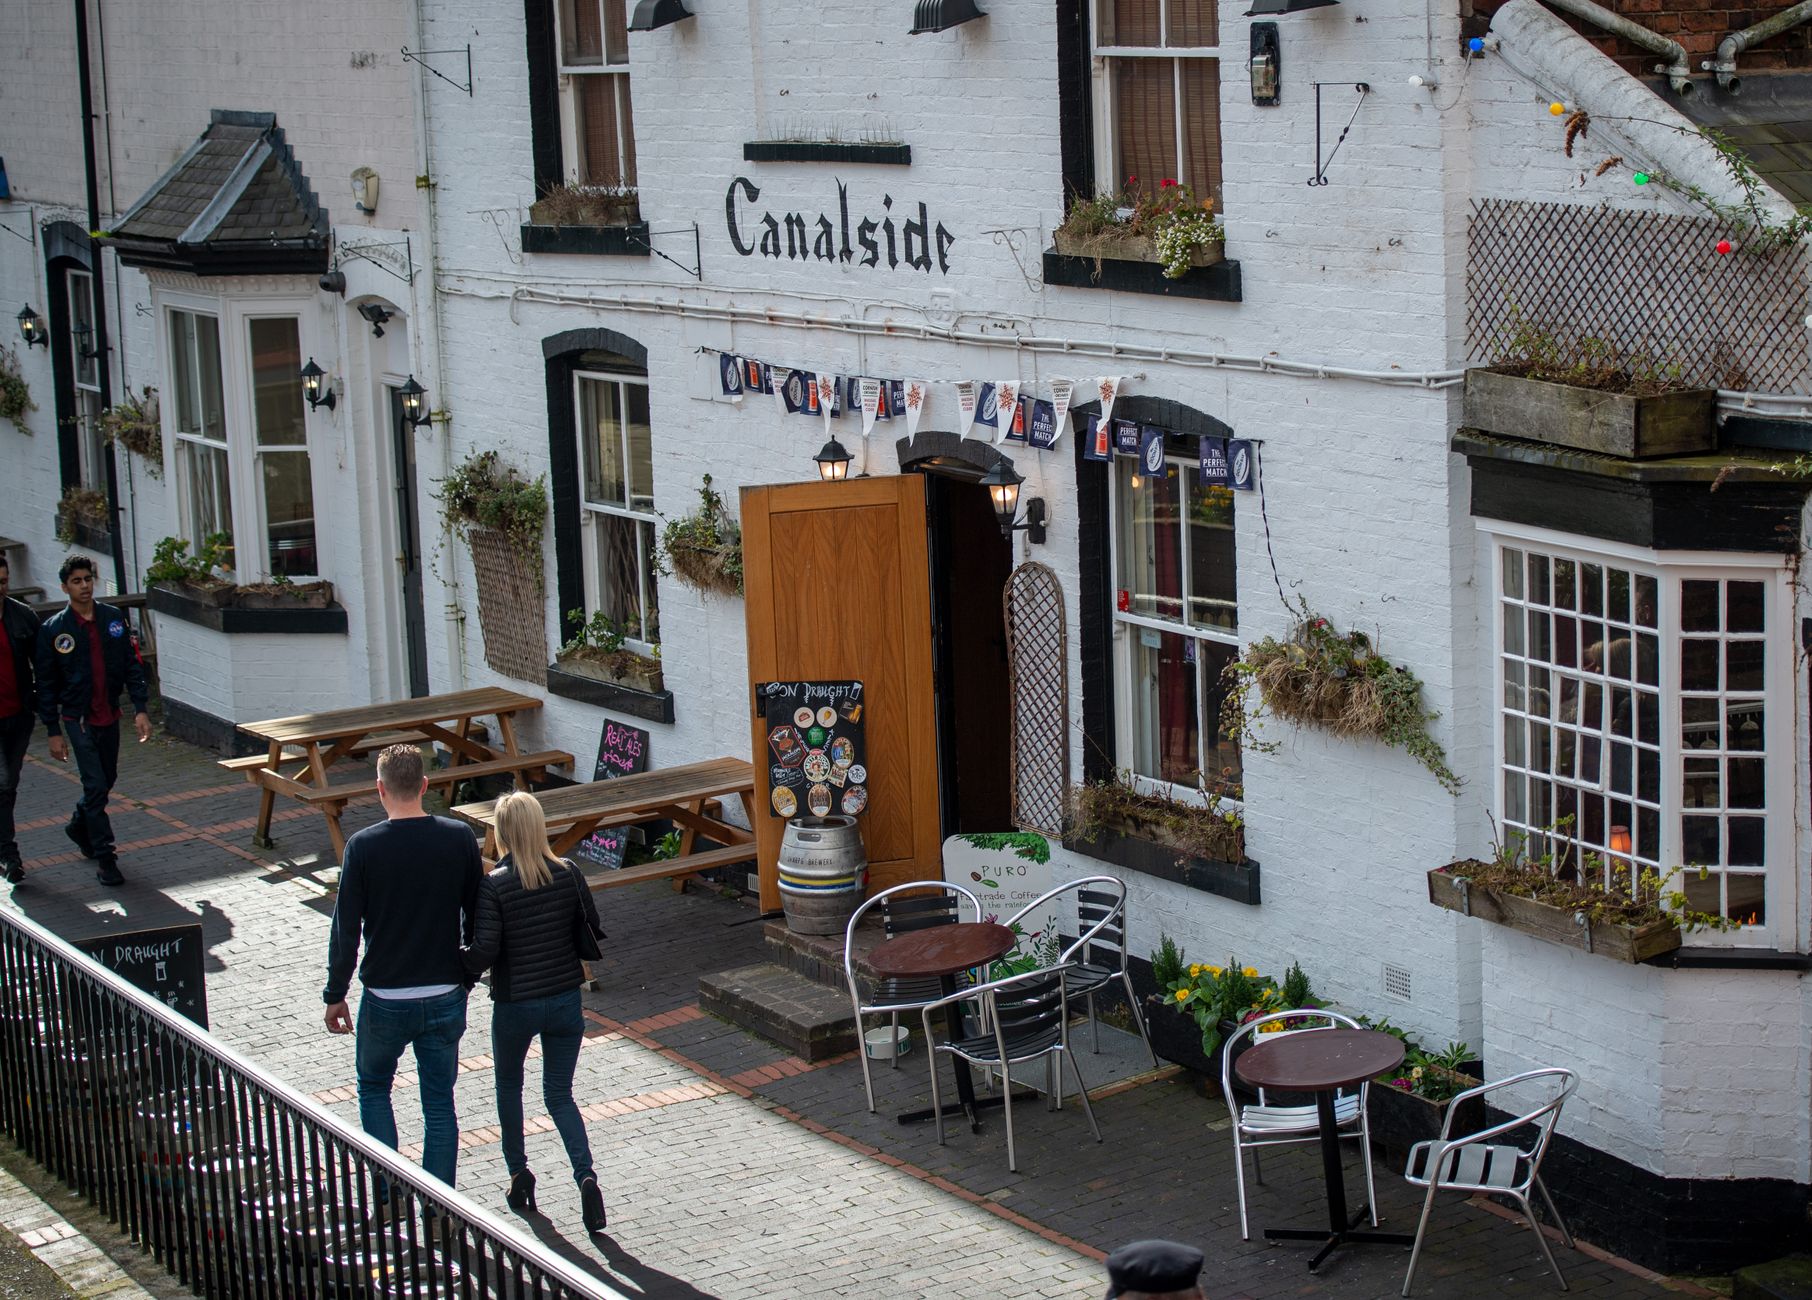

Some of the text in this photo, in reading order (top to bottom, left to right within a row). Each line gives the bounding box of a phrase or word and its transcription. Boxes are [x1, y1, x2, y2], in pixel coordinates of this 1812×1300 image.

[726, 176, 956, 276] Canalside
[1033, 421, 1053, 432] PERFEC
[1121, 436, 1137, 446] MATCH
[1206, 468, 1228, 477] MATCH
[803, 682, 851, 699] DRAUGHT
[604, 723, 643, 757] REAL ALES
[981, 865, 1027, 877] PURO
[1010, 890, 1042, 900] Coffee
[113, 937, 183, 970] DRAUGHT
